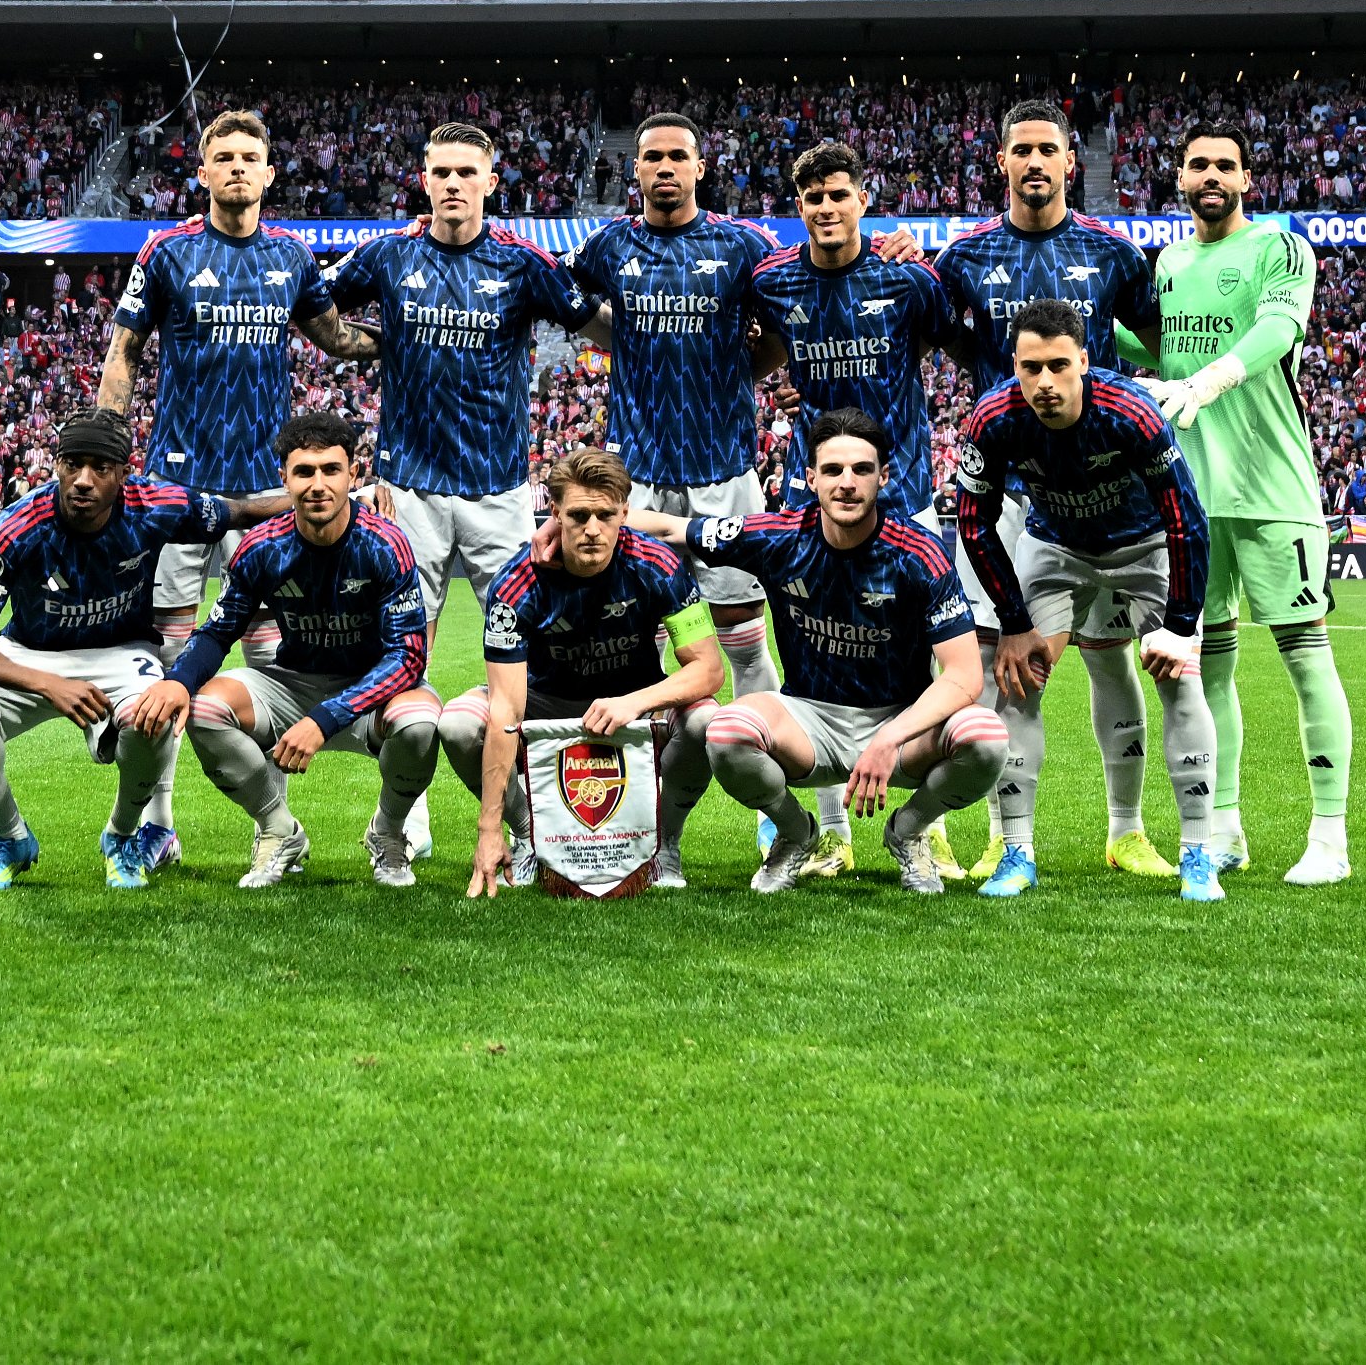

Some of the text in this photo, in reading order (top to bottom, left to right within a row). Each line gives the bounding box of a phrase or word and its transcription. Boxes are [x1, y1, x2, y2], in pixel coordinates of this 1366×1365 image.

[194, 300, 290, 325] Emirates
[622, 290, 720, 314] Emirates
[403, 300, 501, 330] Emirates
[636, 315, 704, 333] FLY BETTER
[210, 326, 279, 345] FLY BETTER
[414, 327, 485, 349] FLY BETTER
[1178, 335, 1218, 355] BETTER
[792, 335, 891, 362] Emirates
[810, 357, 877, 380] FLY BETTER
[1027, 475, 1132, 507] Emirates
[1049, 494, 1121, 519] FLY BETTER
[1292, 537, 1309, 582] 1
[44, 577, 145, 616] Emirates
[59, 599, 133, 628] FLY BETTER
[789, 604, 892, 643] Emirates
[301, 632, 322, 646] FLY
[827, 638, 876, 660] BETTER
[132, 656, 160, 678] 2
[565, 755, 619, 771] Arsenal
[1005, 757, 1025, 770] FC
[1182, 752, 1211, 766] AFC
[544, 833, 572, 843] ATLÉTICO
[582, 834, 607, 843] MADRID
[612, 831, 641, 840] ARSENAL
[642, 830, 650, 838] FC
[577, 844, 608, 852] CHAMPIONS
